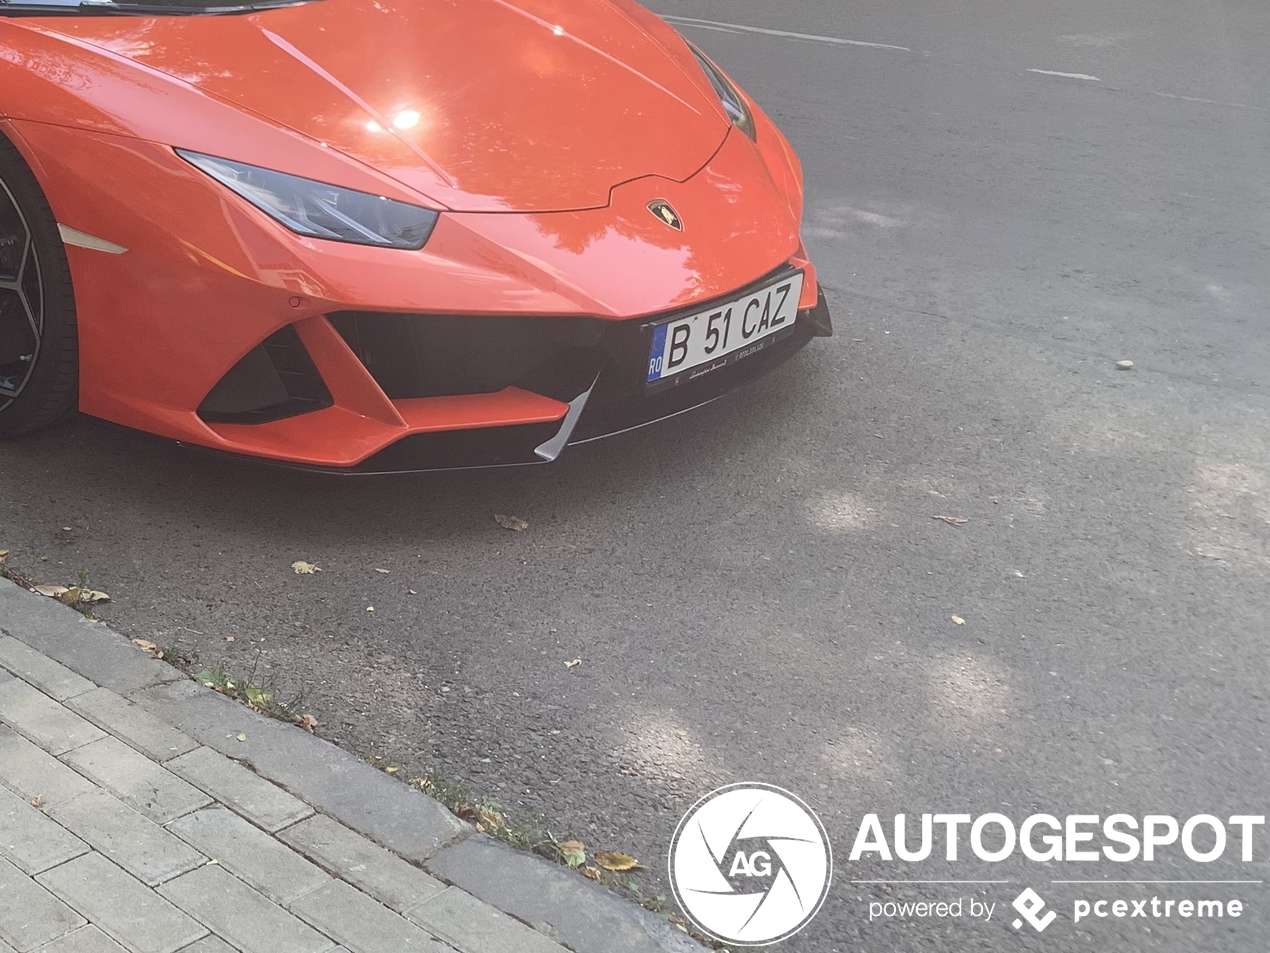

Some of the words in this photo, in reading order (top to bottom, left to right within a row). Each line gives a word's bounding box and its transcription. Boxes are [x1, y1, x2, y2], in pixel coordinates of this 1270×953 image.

[648, 355, 663, 375] RO
[667, 323, 691, 370] B
[704, 308, 733, 355] 51
[741, 283, 792, 339] CAZ
